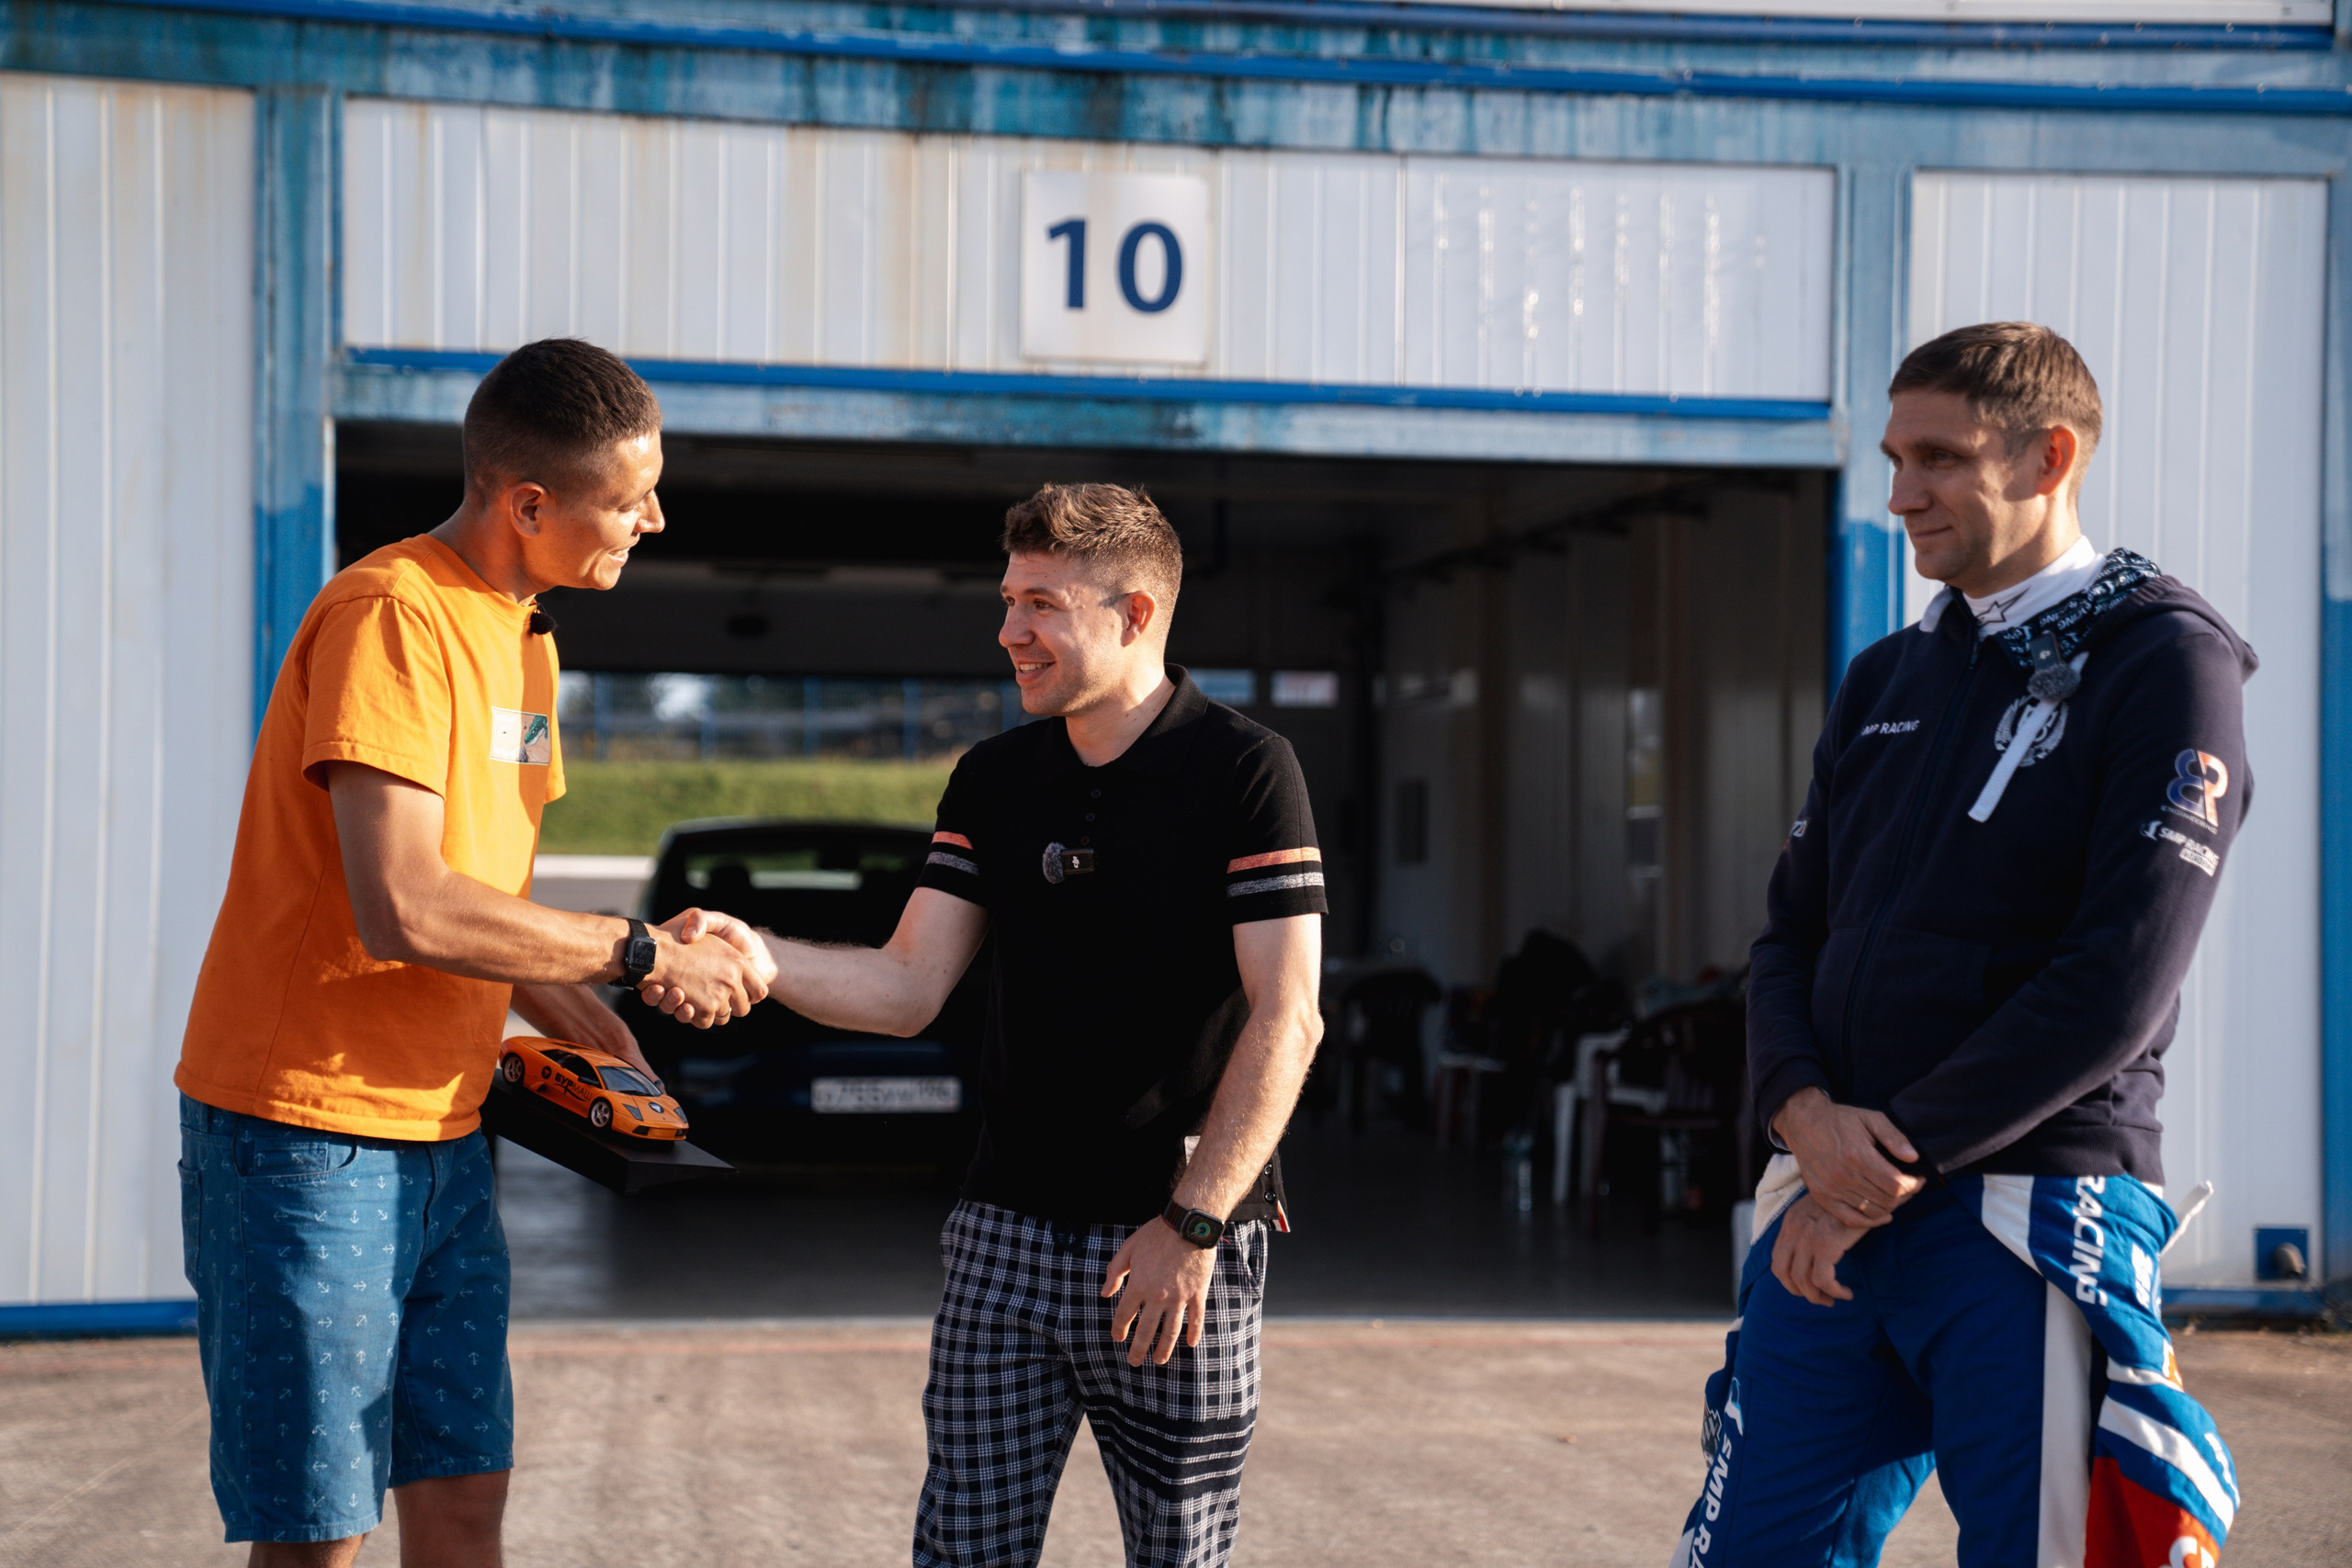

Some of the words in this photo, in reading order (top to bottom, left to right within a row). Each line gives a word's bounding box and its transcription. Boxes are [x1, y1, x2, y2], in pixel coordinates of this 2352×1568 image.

[1047, 218, 1185, 313] 10
[1879, 720, 1920, 734] RACING
[2159, 827, 2188, 846] SMP
[2184, 839, 2221, 867] RACING
[2068, 1176, 2109, 1307] RACING
[1705, 1433, 1733, 1522] SMP
